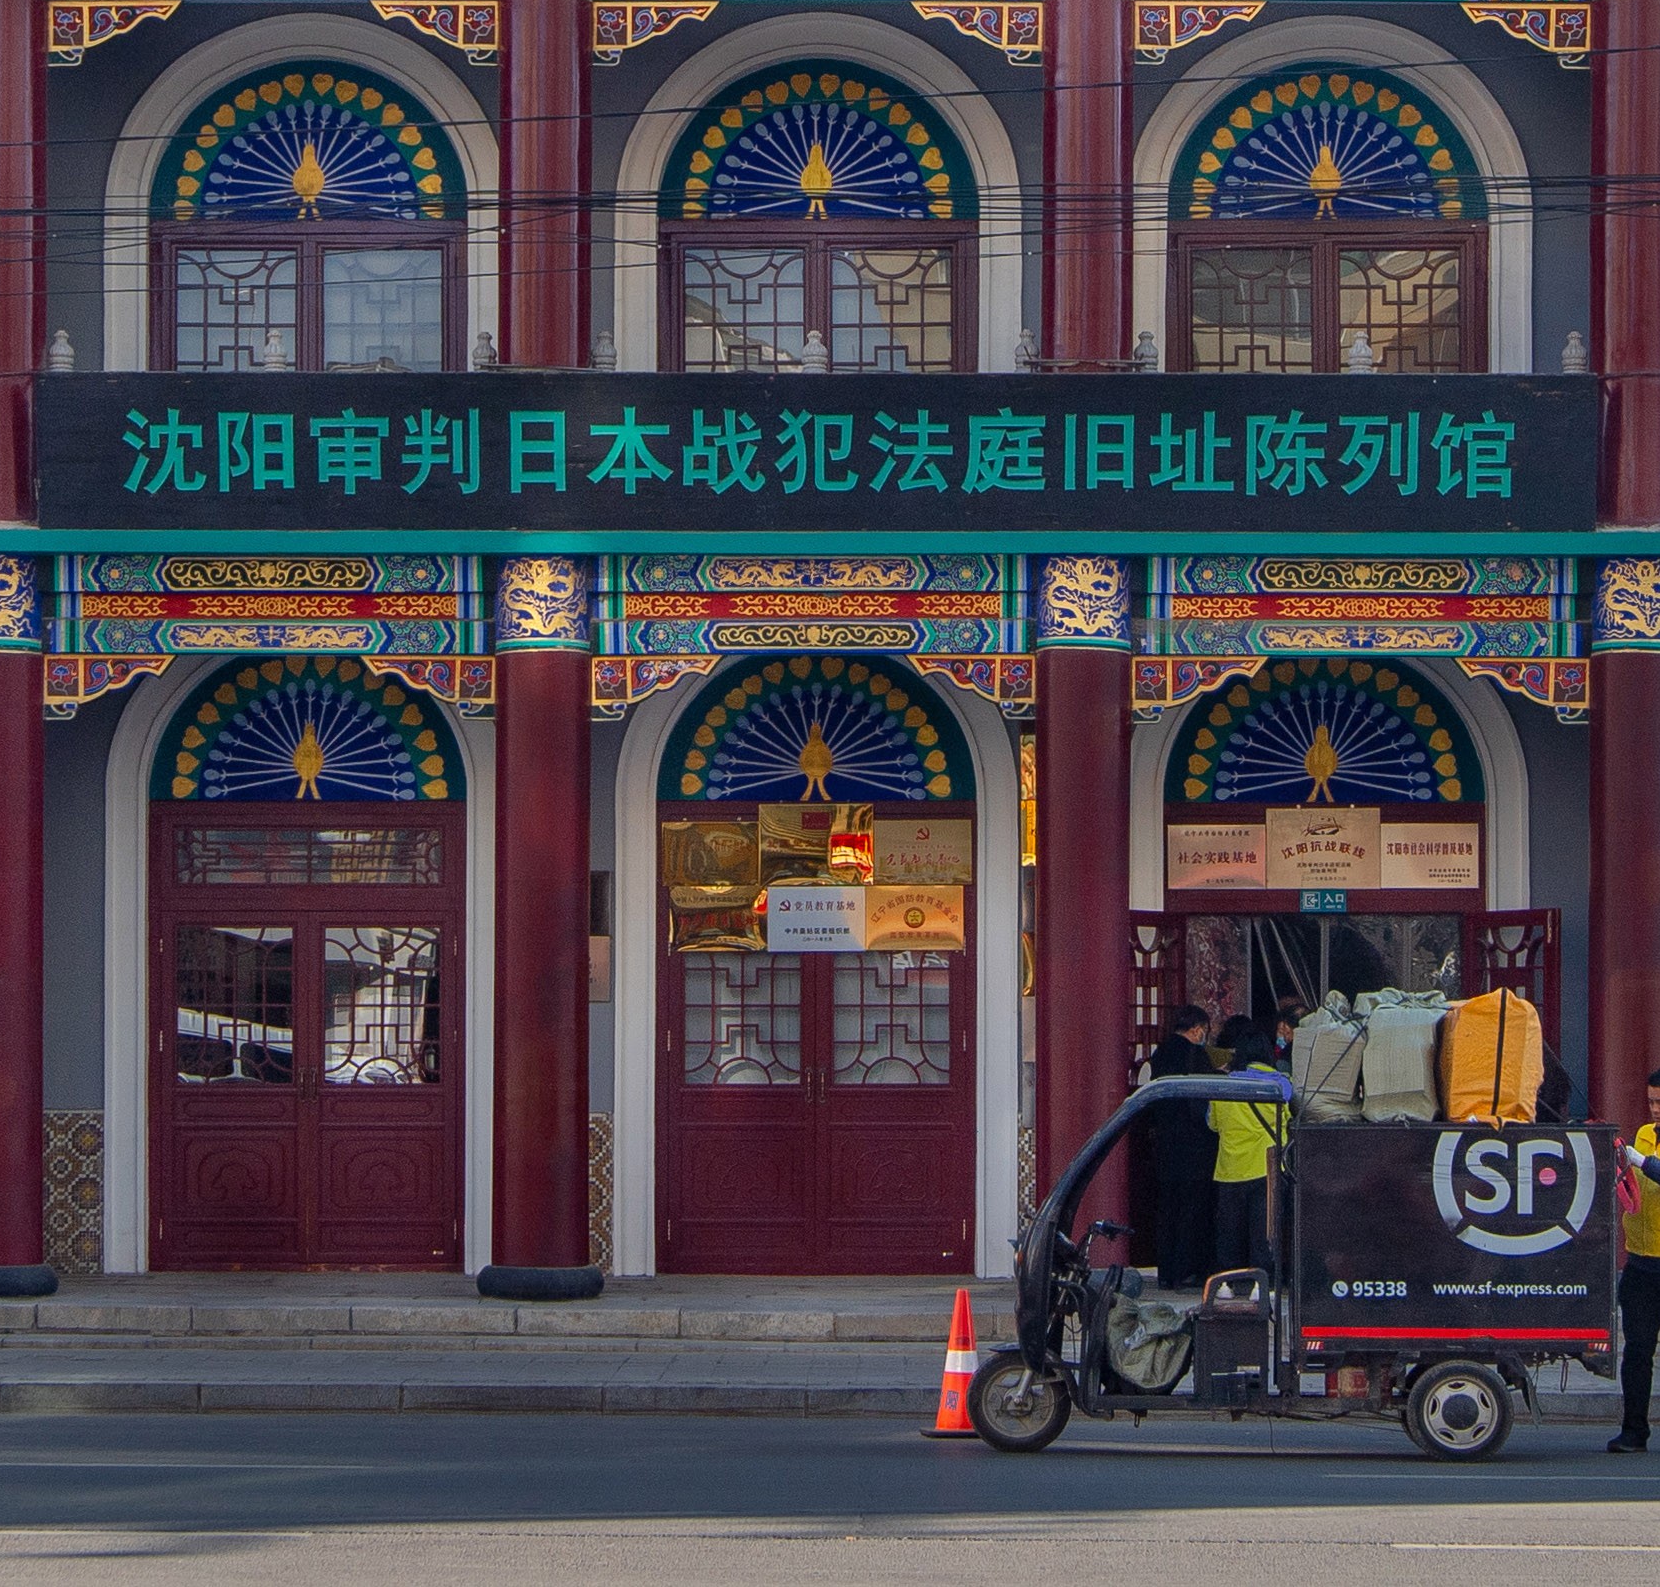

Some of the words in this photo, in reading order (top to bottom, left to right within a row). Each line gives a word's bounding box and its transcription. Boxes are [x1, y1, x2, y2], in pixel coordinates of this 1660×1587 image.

[122, 405, 1517, 500] 沈阳审判日本战犯法庭旧址陈列馆
[1177, 850, 1258, 865] 社会实践基地
[1281, 840, 1366, 860] 沈阳抗战联线
[794, 899, 856, 912] 党员教育基地
[1323, 893, 1345, 903] 入口
[1464, 1139, 1565, 1216] SF
[1352, 1280, 1408, 1298] 95338
[1432, 1281, 1589, 1300] www.sf-express.com
